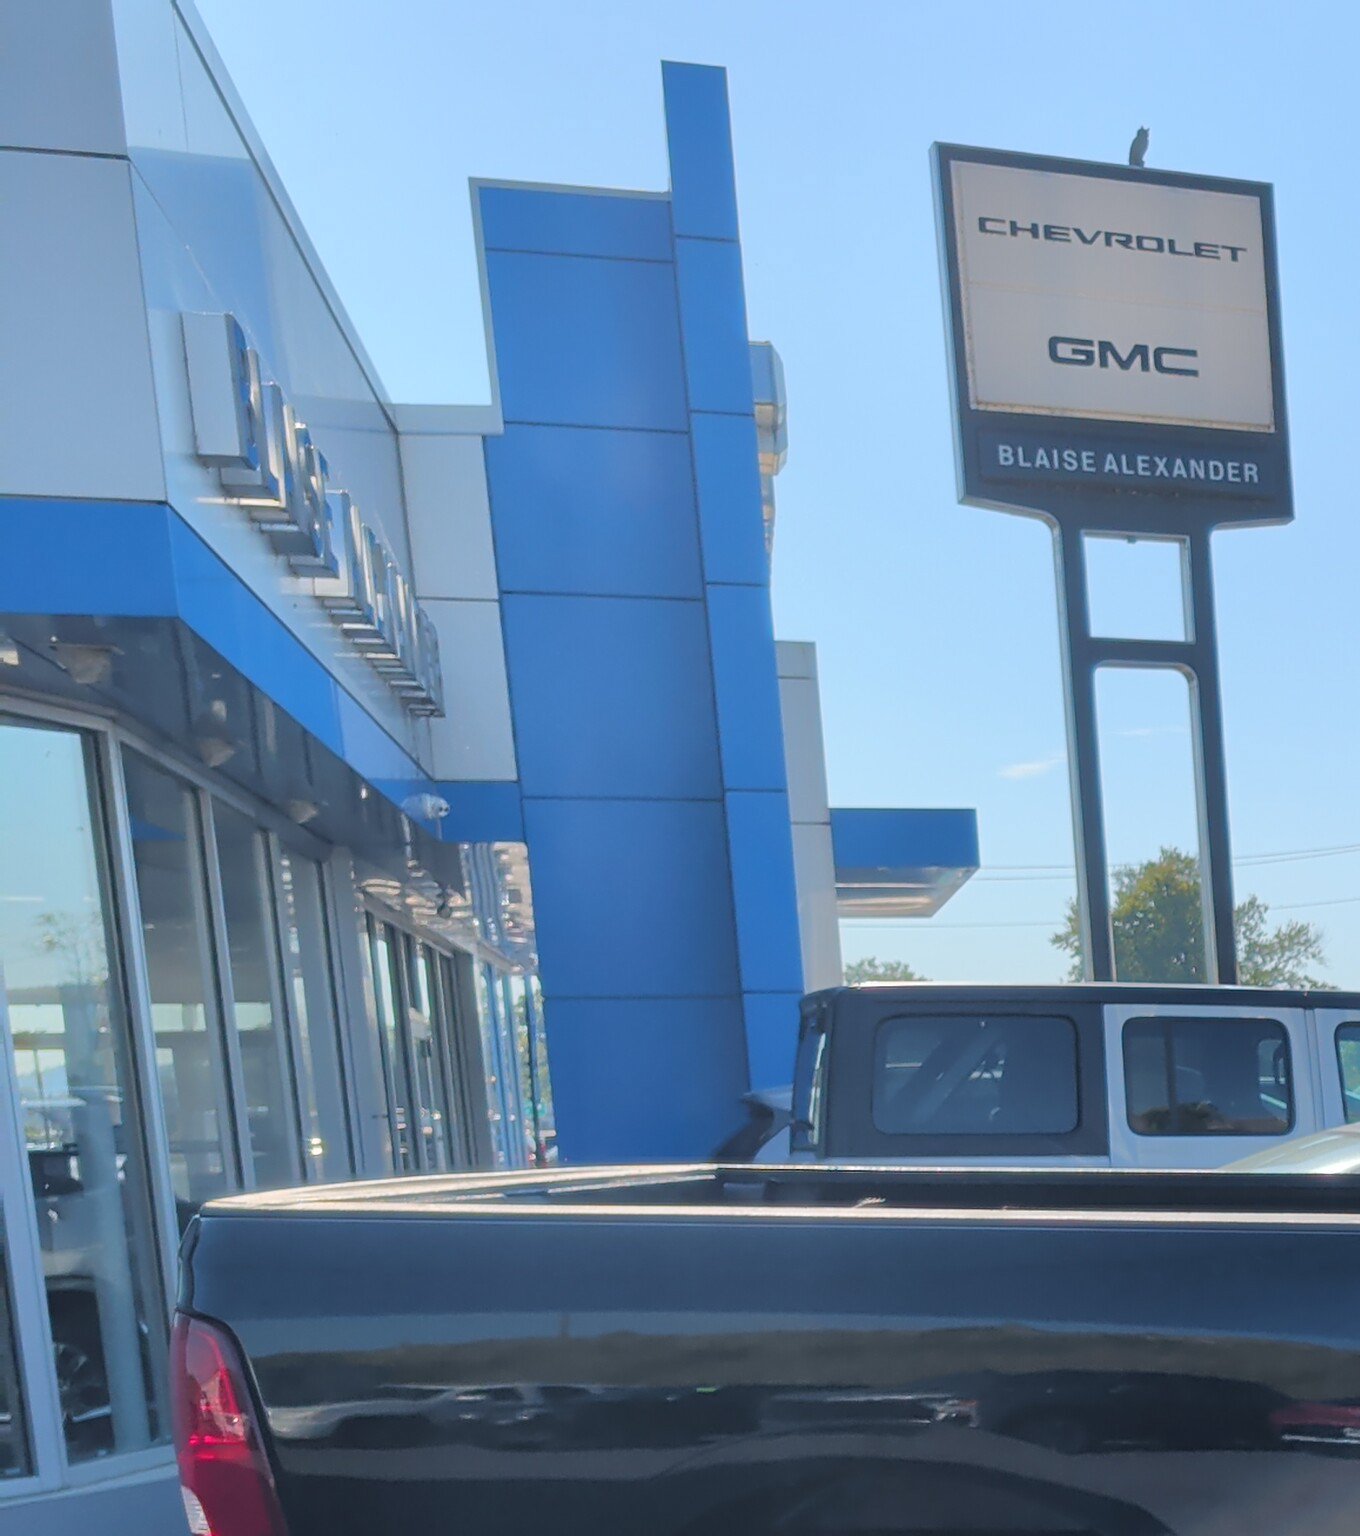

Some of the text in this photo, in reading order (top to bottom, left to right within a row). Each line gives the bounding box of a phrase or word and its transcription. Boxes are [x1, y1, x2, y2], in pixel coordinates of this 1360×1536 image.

[978, 216, 1247, 262] CHEVROLET
[1049, 335, 1199, 377] GMC
[998, 444, 1259, 484] BLAISE ALEXANDER
